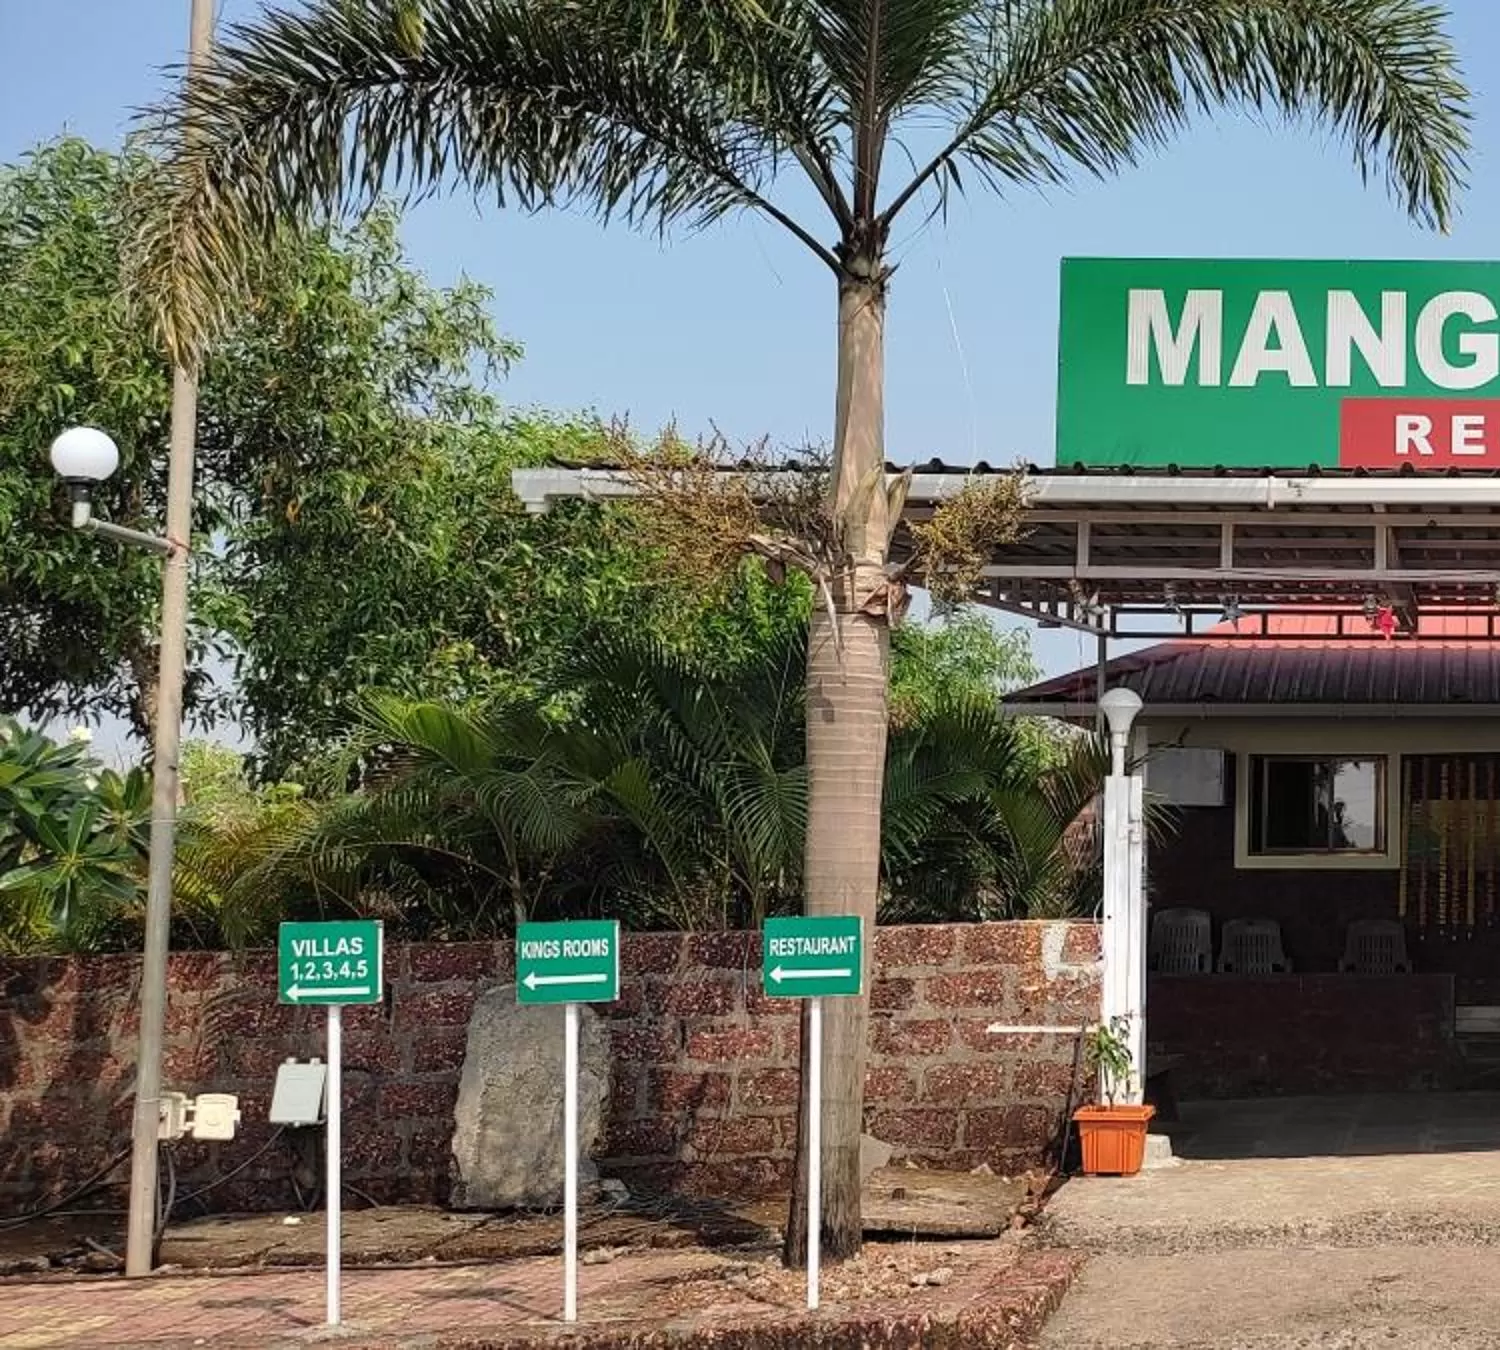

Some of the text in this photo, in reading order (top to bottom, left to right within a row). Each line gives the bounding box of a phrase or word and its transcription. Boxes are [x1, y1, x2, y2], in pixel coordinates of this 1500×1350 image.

[291, 937, 364, 957] VILLAS
[521, 938, 609, 960] KINGS ROOMS
[769, 935, 857, 957] RESTAURANT
[289, 960, 369, 981] 1,2,3,4,5
